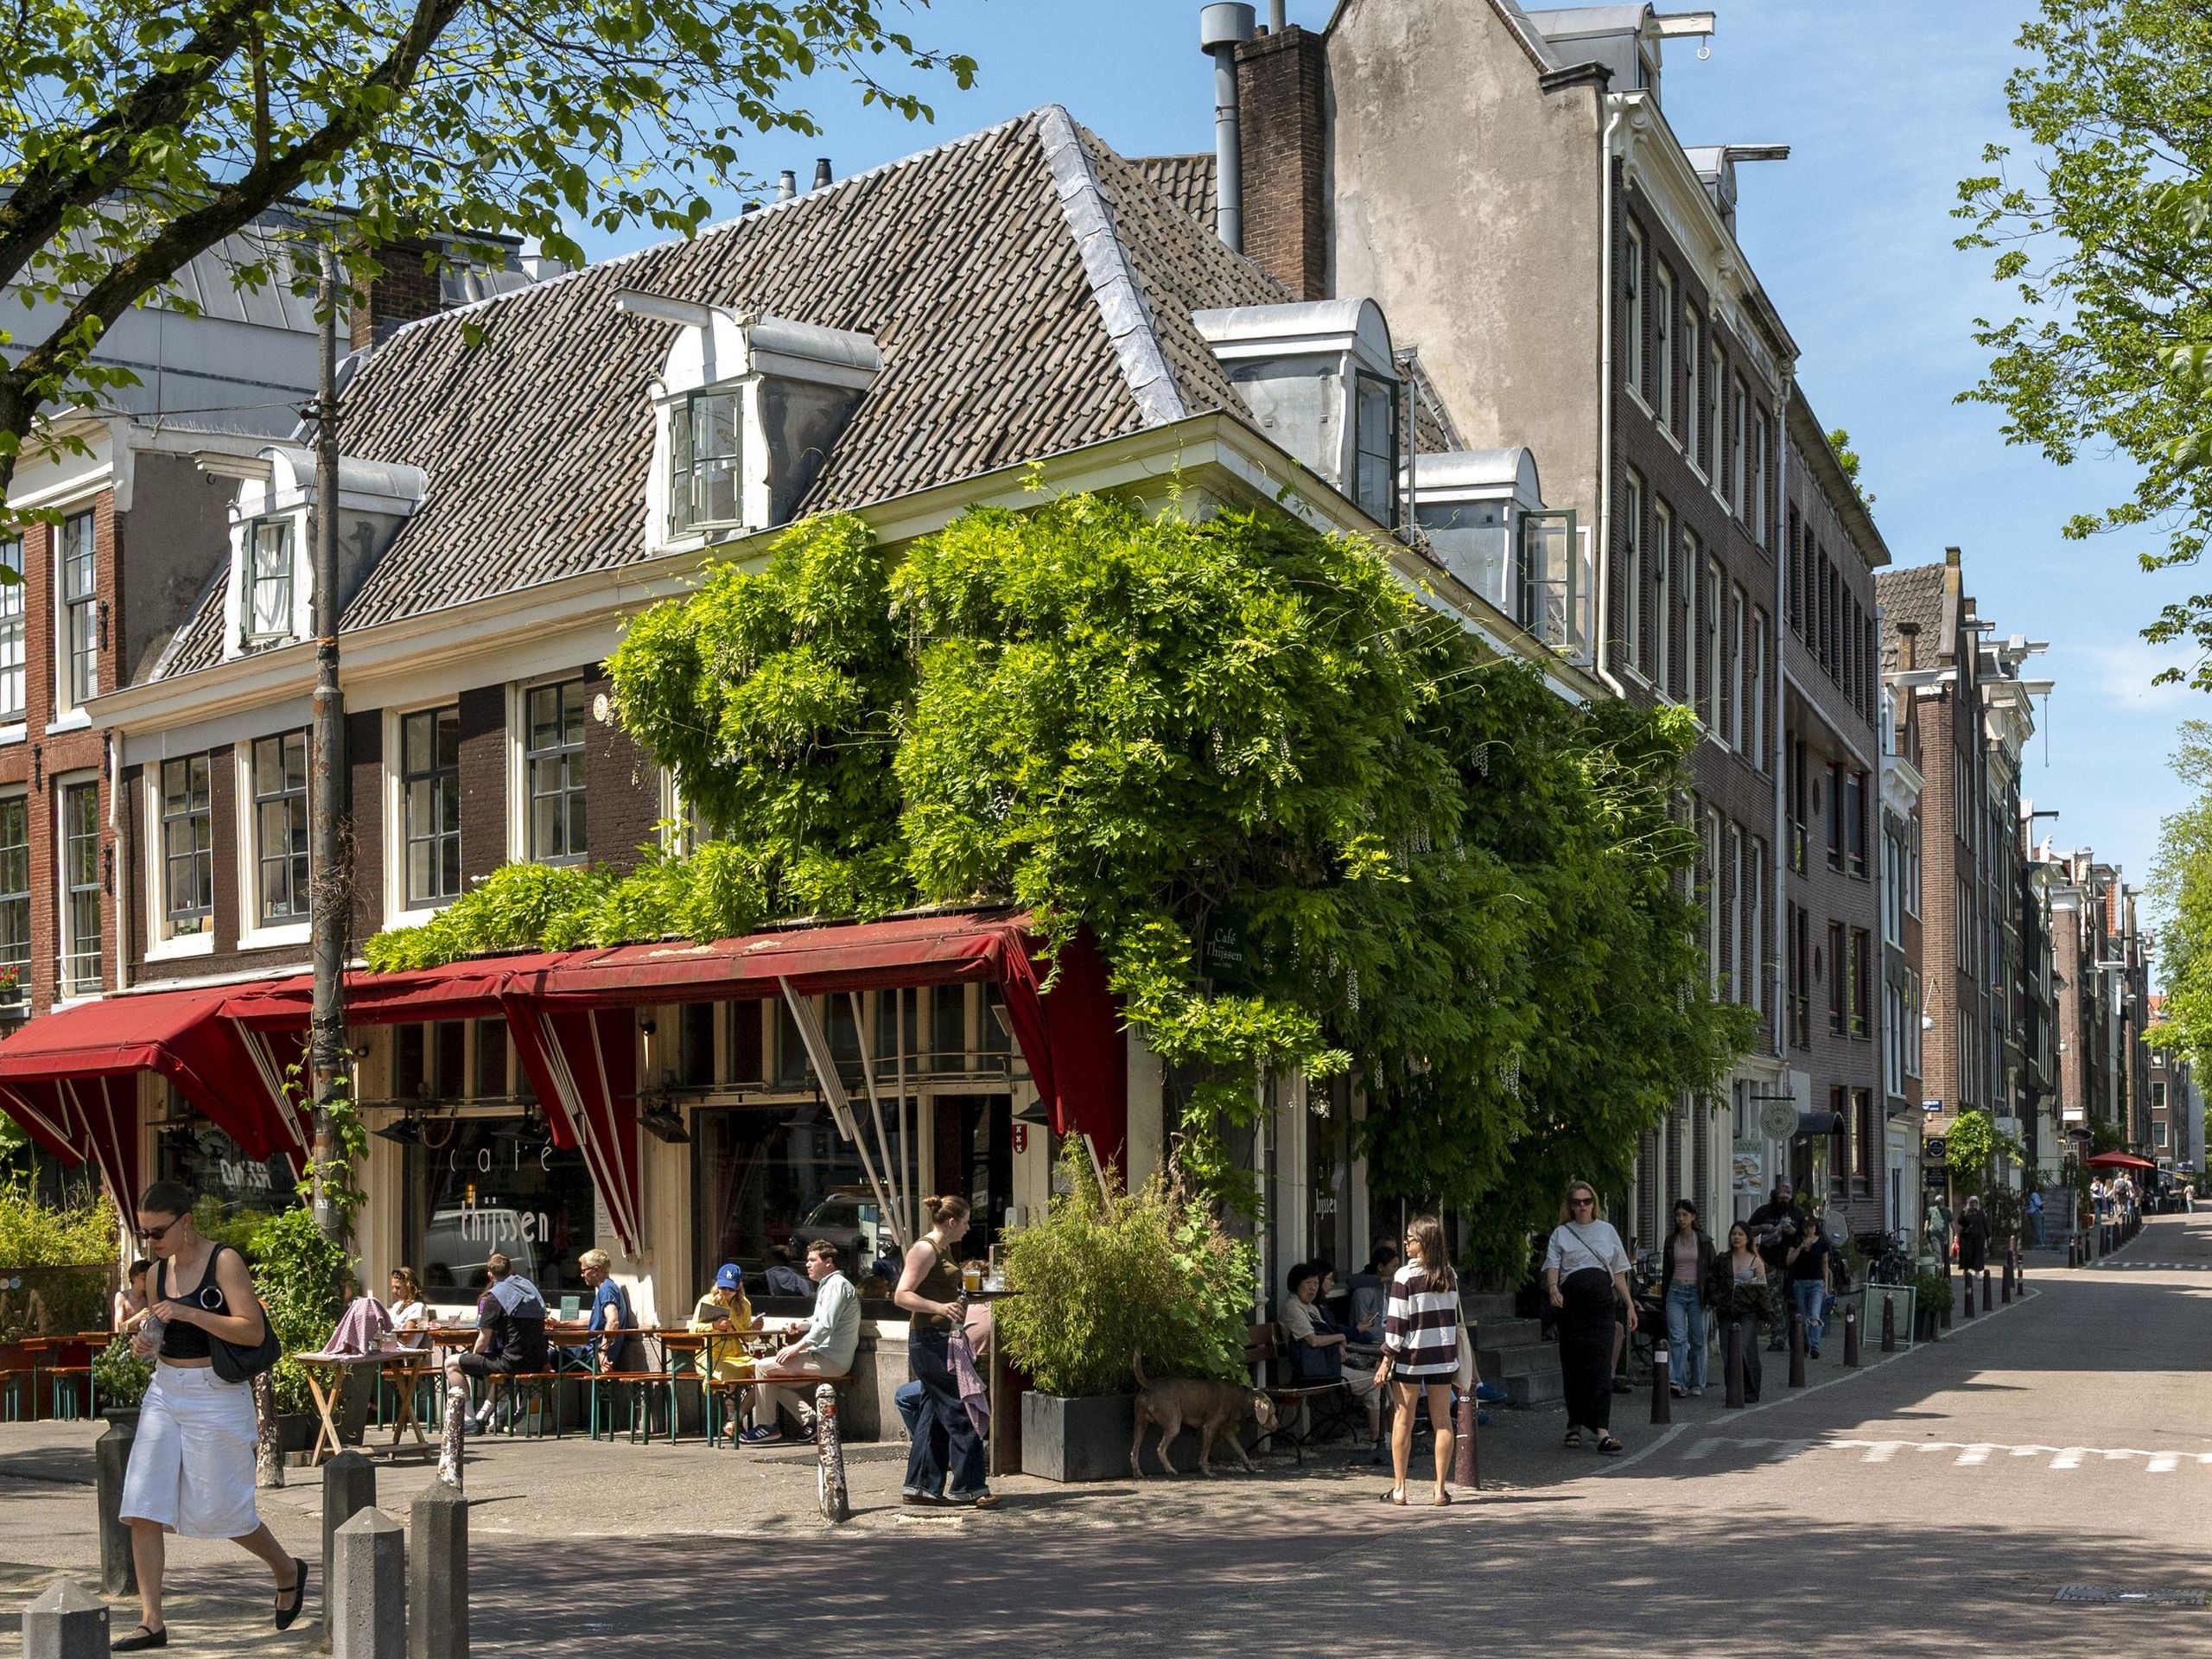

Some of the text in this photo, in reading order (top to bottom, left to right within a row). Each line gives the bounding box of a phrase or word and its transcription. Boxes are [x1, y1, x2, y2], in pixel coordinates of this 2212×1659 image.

[1214, 928, 1236, 945] Café
[1205, 940, 1243, 961] Thijssen
[461, 1191, 549, 1255] thijssen
